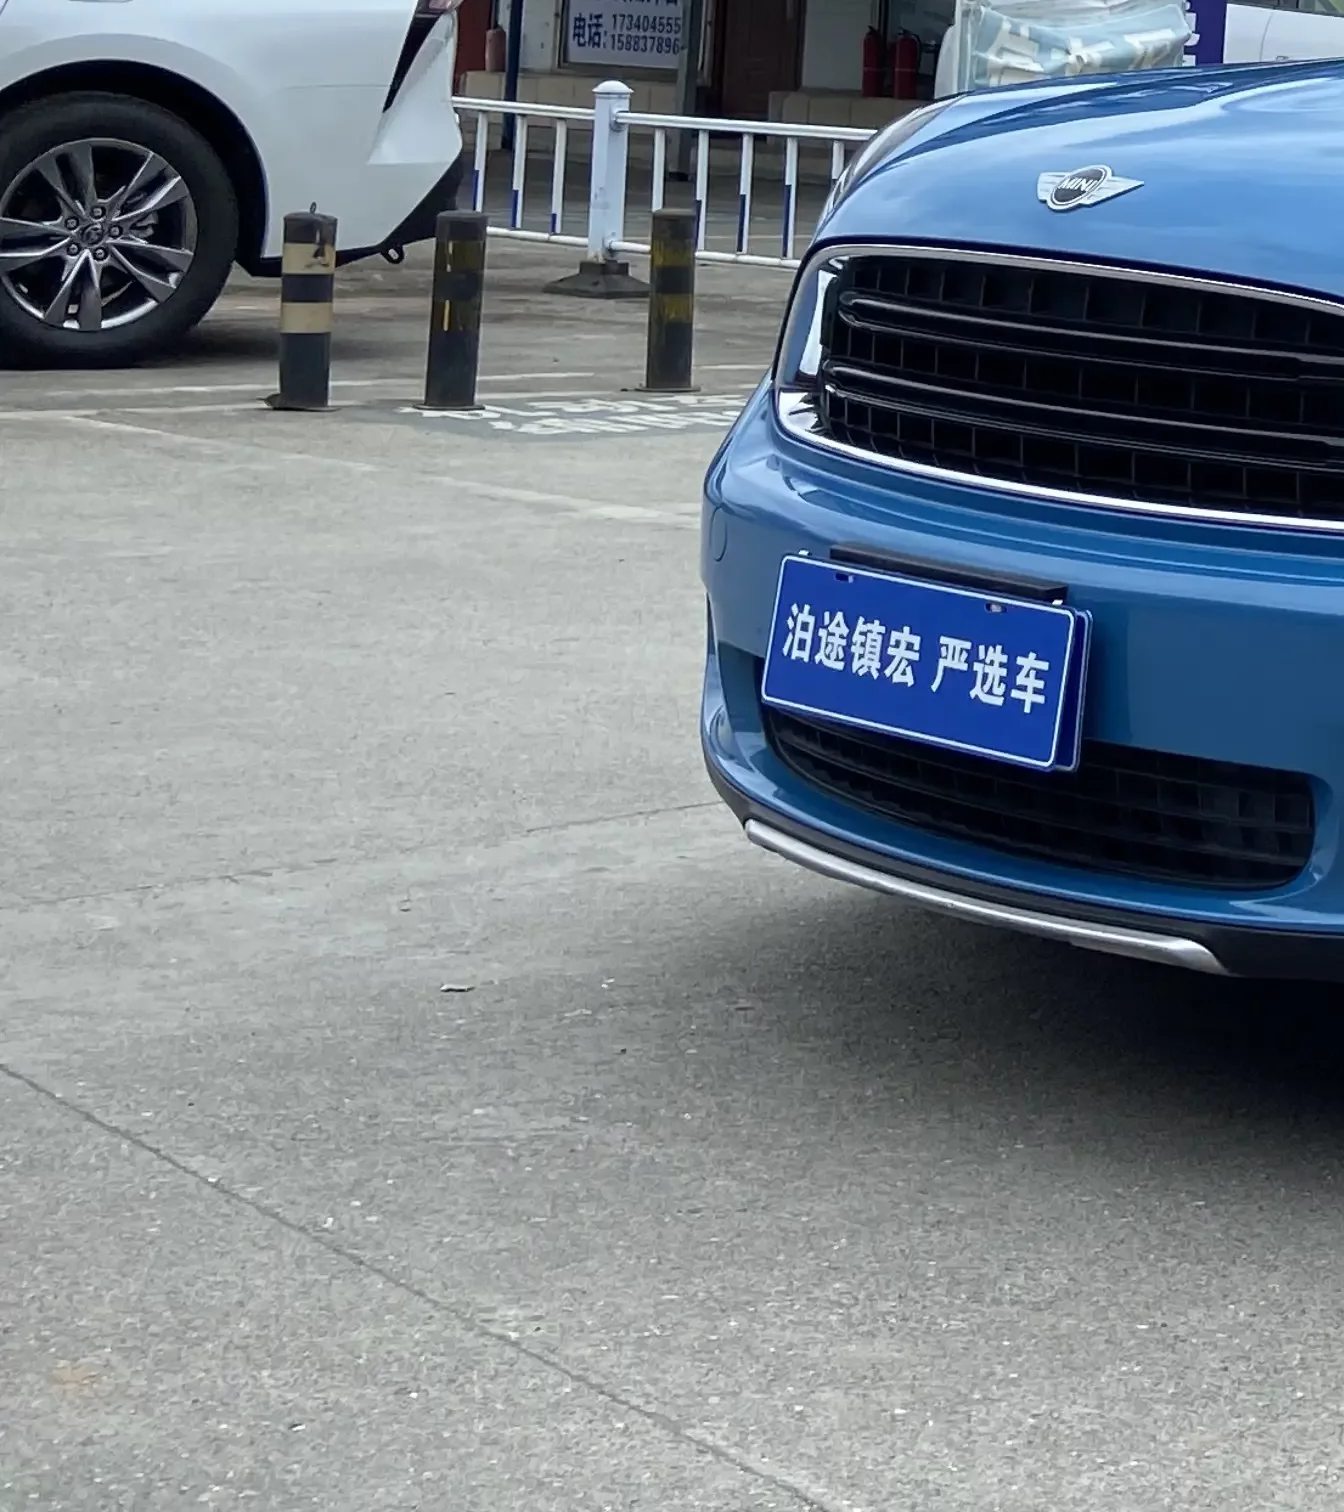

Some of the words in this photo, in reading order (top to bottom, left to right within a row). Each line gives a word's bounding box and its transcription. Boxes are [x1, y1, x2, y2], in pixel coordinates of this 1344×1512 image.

[611, 13, 682, 35] 173404555
[782, 603, 922, 688] 泊途镇宏
[930, 634, 1050, 714] 严选车
